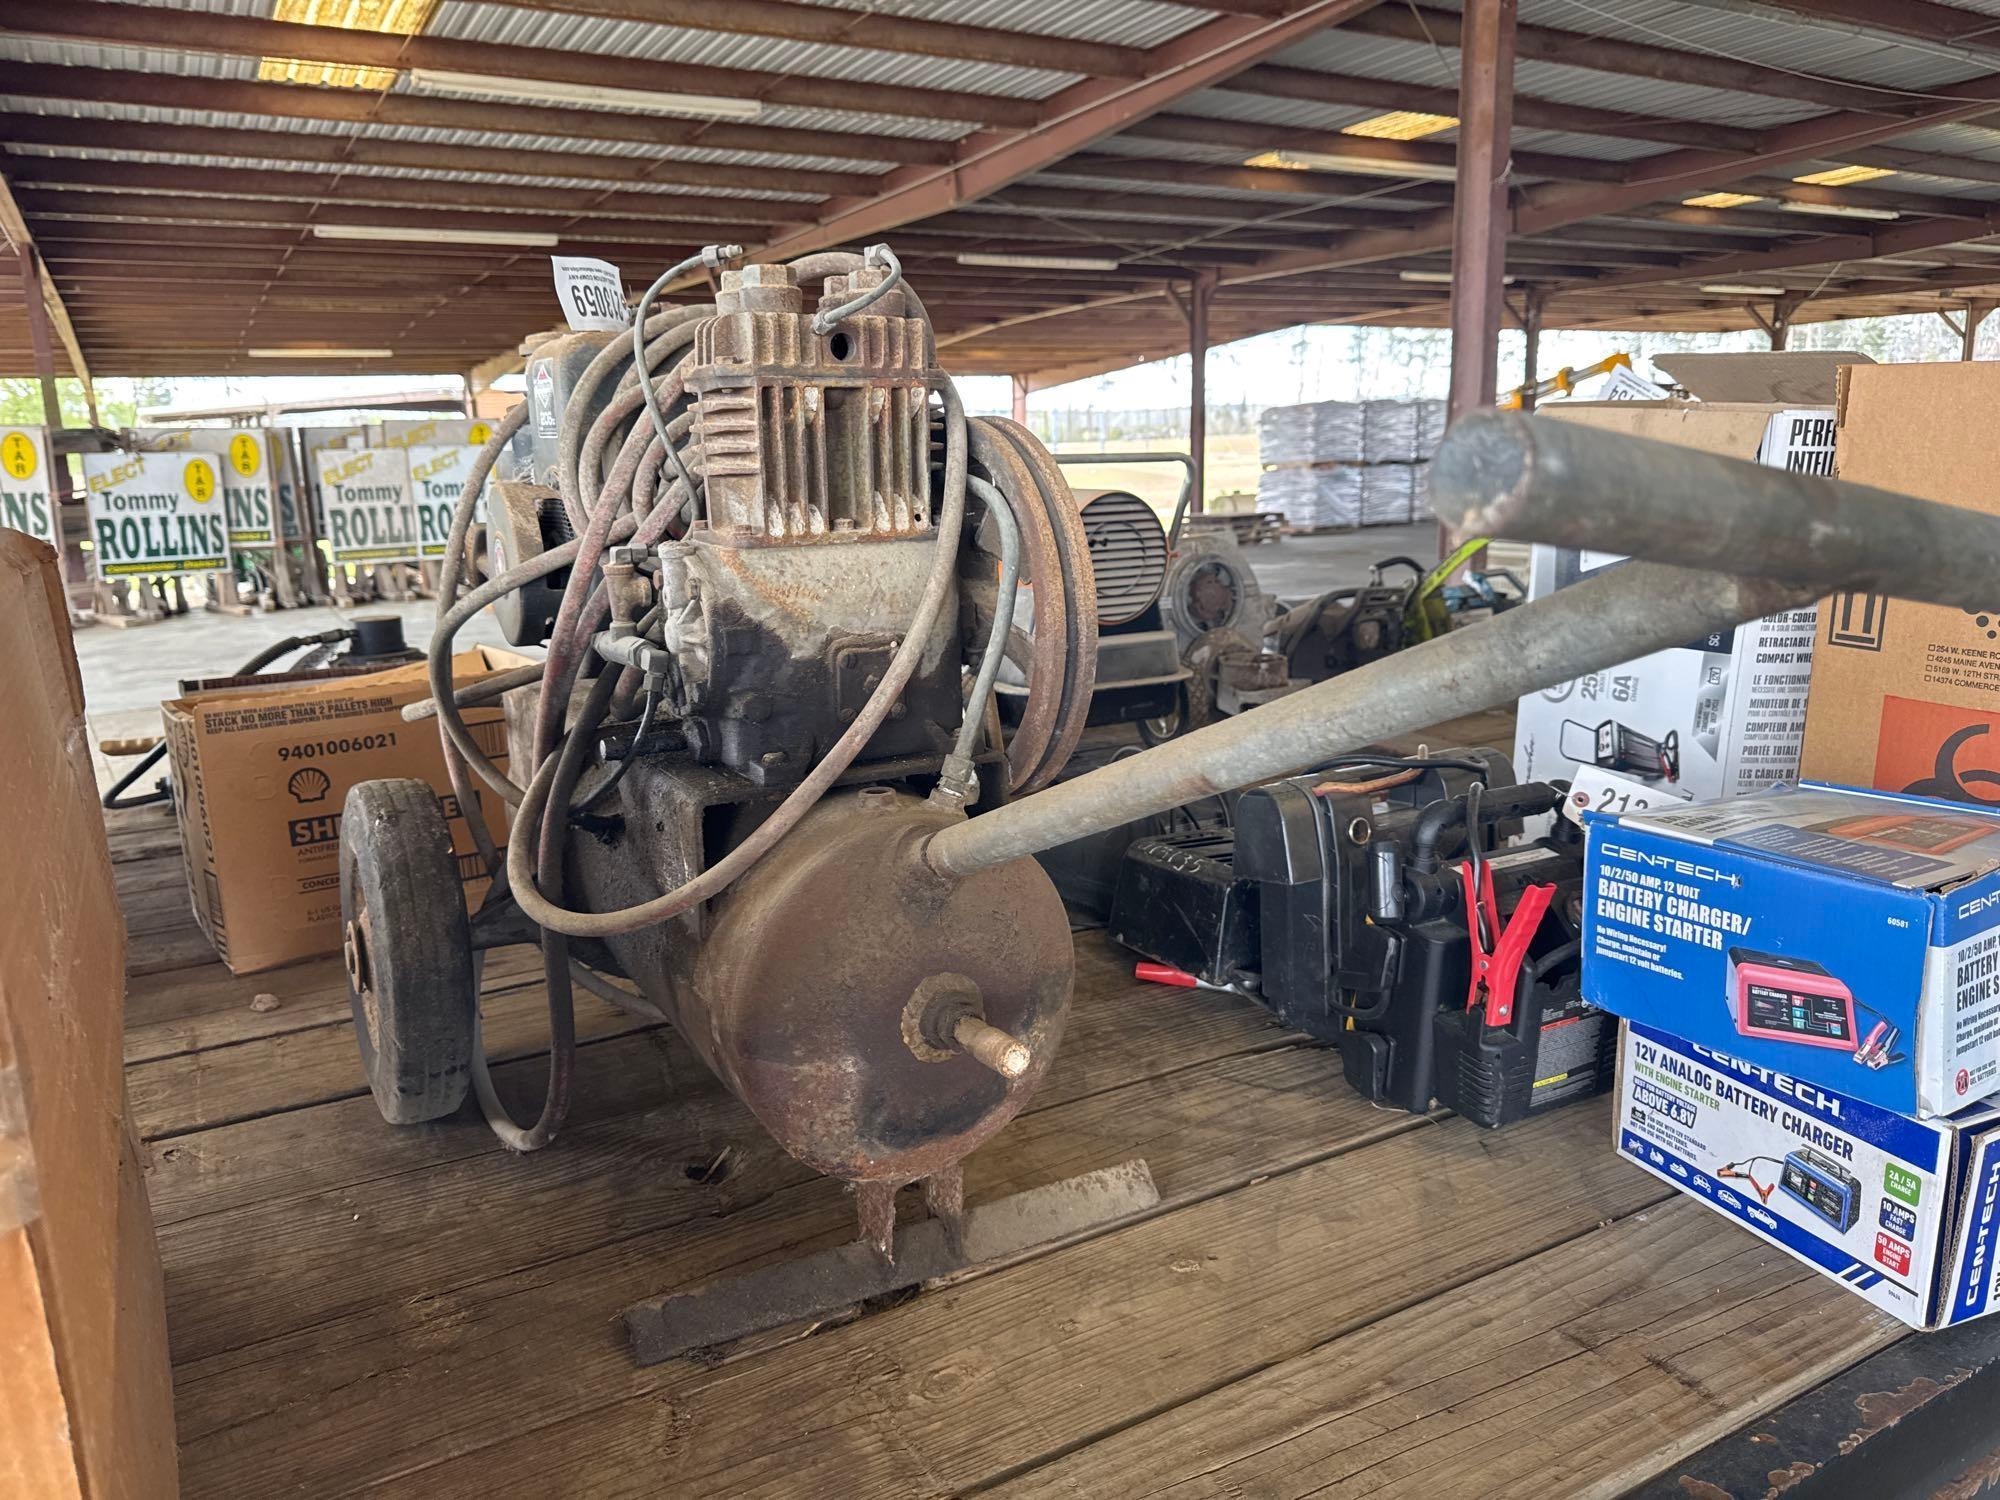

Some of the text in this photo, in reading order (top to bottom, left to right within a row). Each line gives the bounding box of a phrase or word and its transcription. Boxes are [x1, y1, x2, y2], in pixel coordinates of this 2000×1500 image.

[89, 455, 145, 493] ELECT
[101, 491, 179, 513] Tommy
[335, 484, 402, 504] Tommy
[2, 492, 48, 536] NS
[95, 514, 225, 559] ROLLINS
[1759, 637, 1811, 647] RETRACTABLE
[1936, 645, 1949, 653] 254
[1961, 647, 1988, 658] KEENE
[1756, 653, 1795, 663] COMPACT
[1934, 655, 1952, 664] 4245
[1953, 657, 1977, 668] MAINE
[1933, 675, 1953, 685] 14374
[1963, 669, 1981, 678] 12TH
[1612, 675, 1632, 703] 6A
[205, 717, 239, 728] STACK
[240, 713, 256, 724] NO
[258, 710, 289, 722] MORE
[290, 706, 317, 718] THAN
[319, 705, 325, 715] 2
[328, 700, 368, 713] PALLETS
[370, 696, 393, 707] HIGH
[1745, 722, 1787, 732] COMPTEUR
[278, 732, 397, 761] 9401006021
[1773, 745, 1798, 756] TOTALE
[1739, 768, 1752, 779] LES
[1754, 767, 1784, 779] CÂBLES
[1601, 842, 1740, 886] CEN-TECH
[1600, 864, 1638, 884] 10/2/50
[1664, 880, 1674, 893] 12
[1676, 883, 1700, 900] VOLT
[1599, 878, 1752, 936] BATTERY CHARGER/
[1597, 898, 1723, 950] ENGINE STARTER
[1606, 927, 1628, 942] Wiring
[1629, 955, 1637, 965] 12
[1957, 941, 1982, 963] 10/2/50
[1956, 951, 1999, 988] BATTERY
[1956, 980, 1991, 1013] ENGINE
[1634, 1062, 1720, 1111] WITH ENGINE STARTER
[1634, 1041, 1657, 1065] 12V
[1659, 1053, 1712, 1092] ANALOG
[1715, 1079, 1779, 1124] BATTERY
[1781, 1111, 1854, 1163] CHARGER
[1634, 1085, 1695, 1128] ABOVE 6.8V
[1888, 1169, 1899, 1182] 2A
[1906, 1177, 1917, 1191] 5A
[1890, 1181, 1912, 1197] CHARGE
[1882, 1200, 1916, 1224] 10 AMPS
[1889, 1215, 1904, 1227] FAST
[1885, 1220, 1907, 1237] CHARGE
[1965, 1161, 2000, 1307] CEN-TECH
[1877, 1235, 1911, 1259] 50 AMPS
[1882, 1247, 1902, 1263] ENGINE
[1882, 1256, 1900, 1270] START
